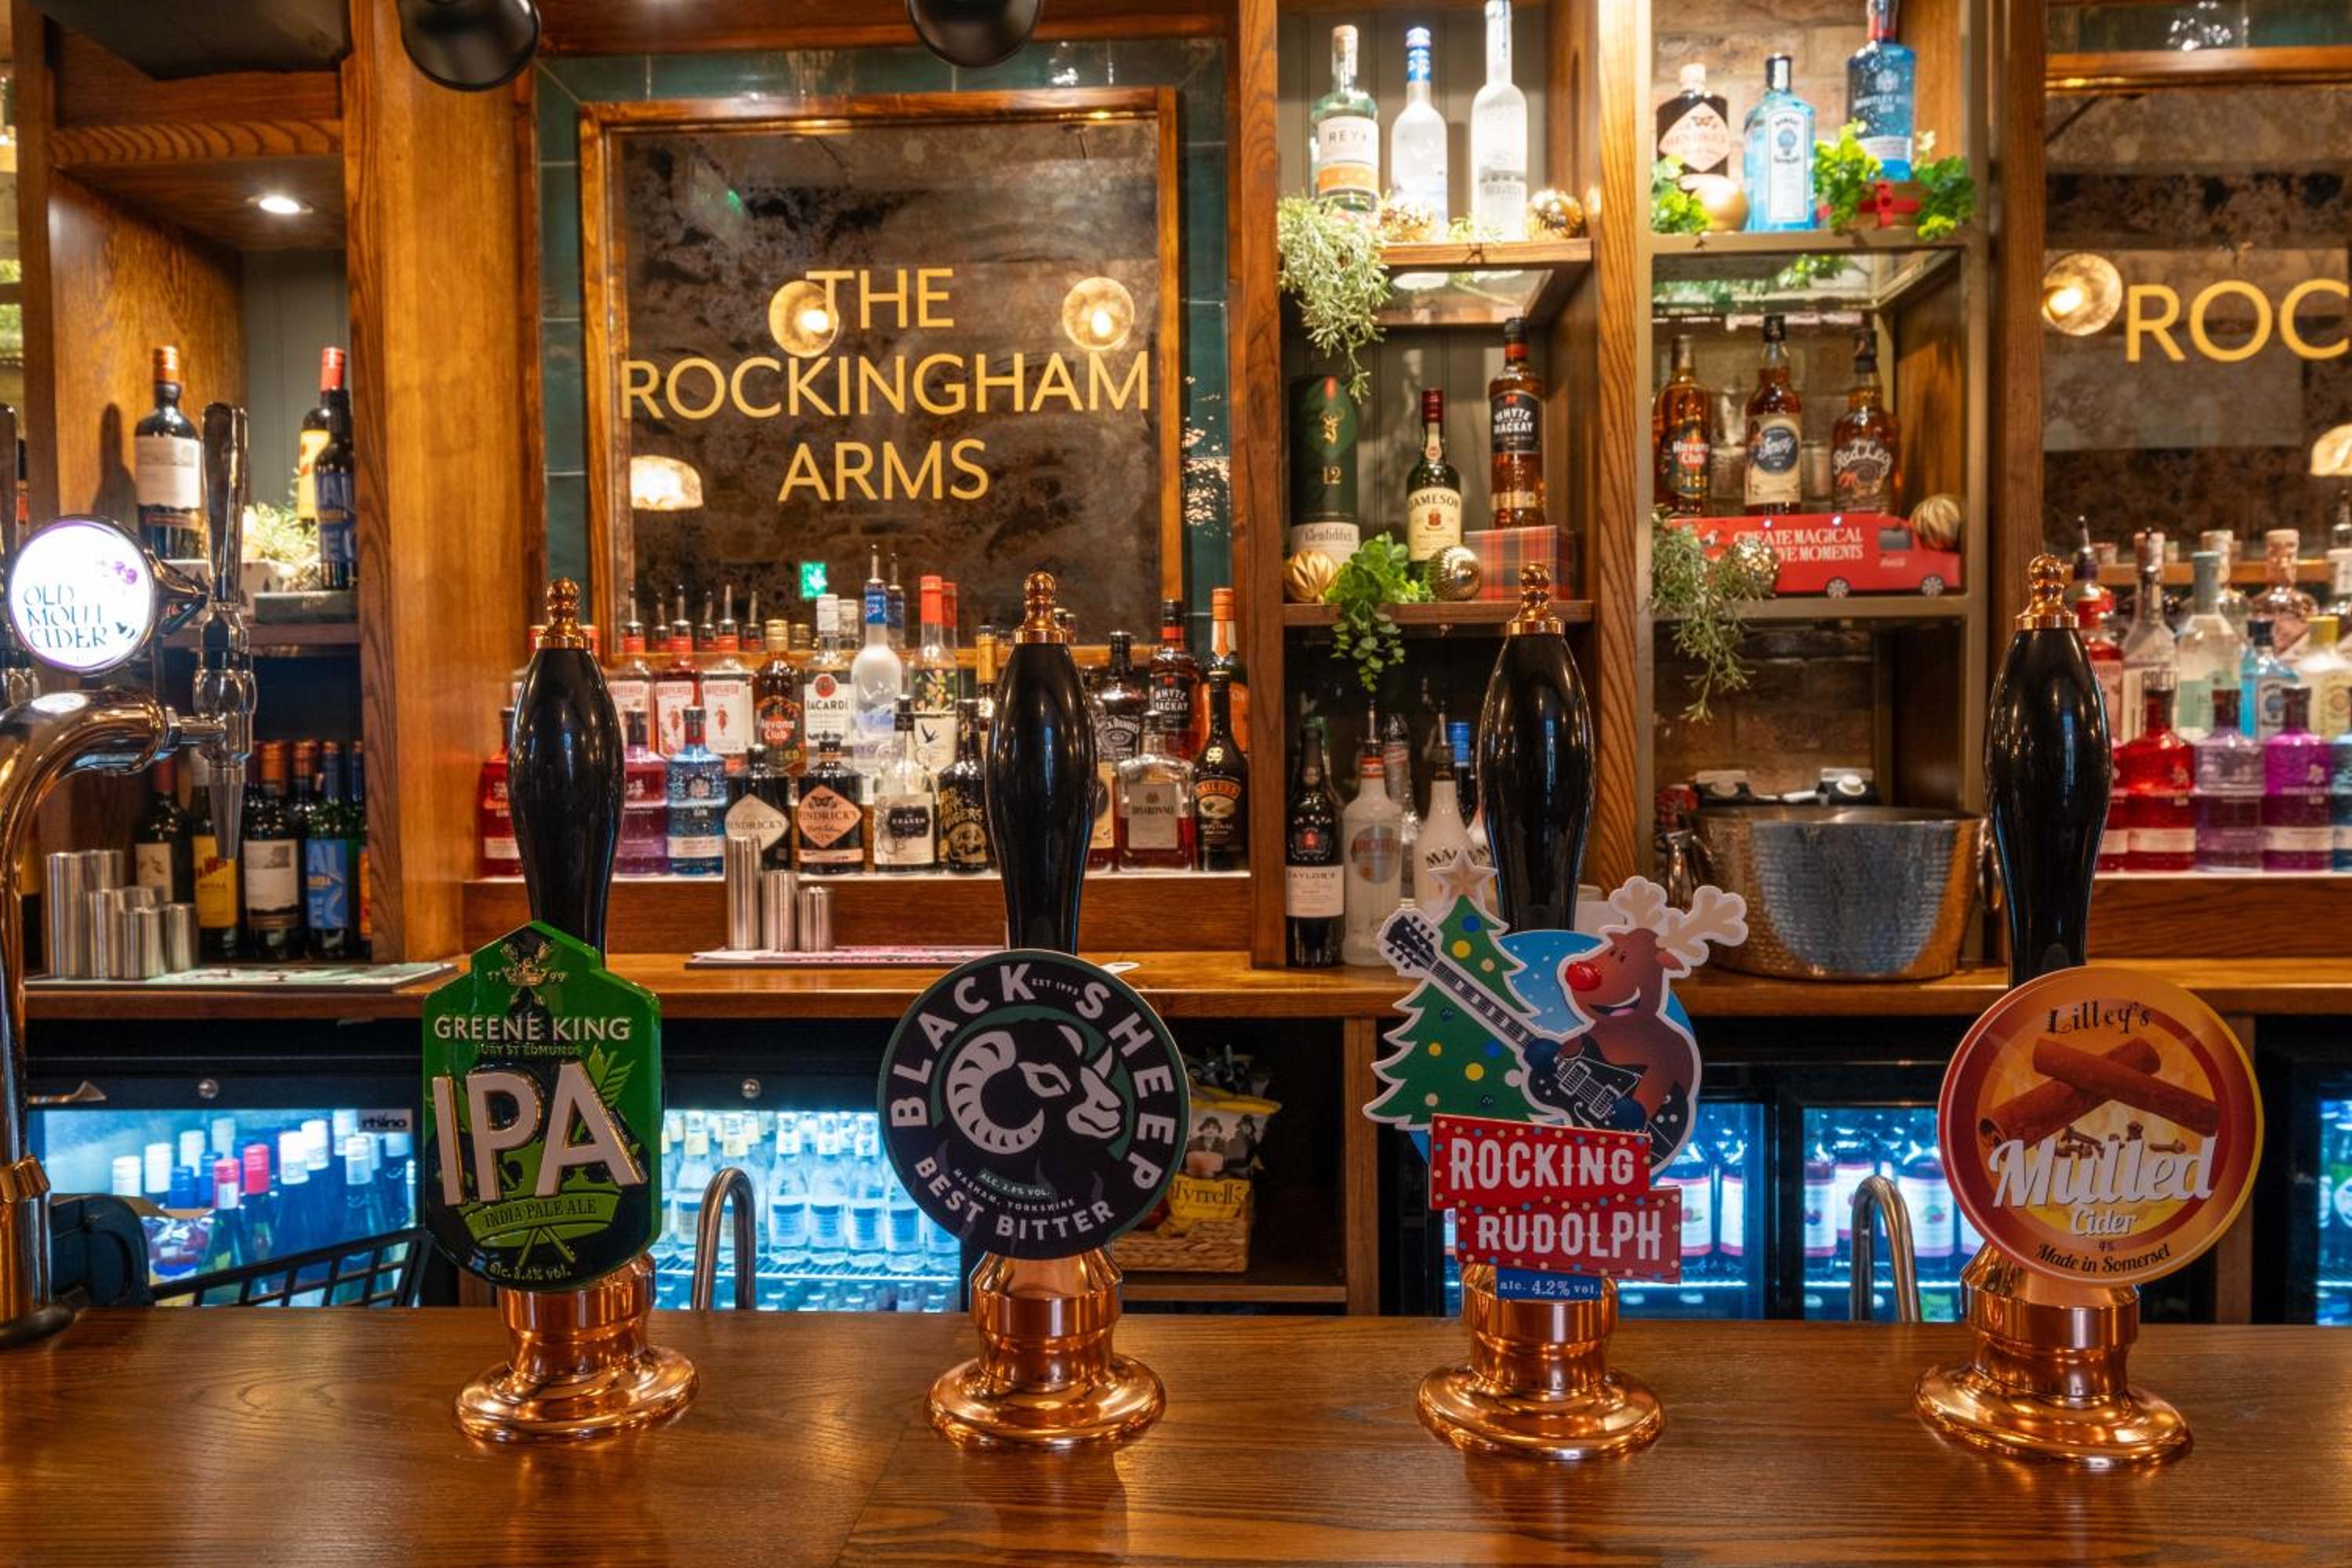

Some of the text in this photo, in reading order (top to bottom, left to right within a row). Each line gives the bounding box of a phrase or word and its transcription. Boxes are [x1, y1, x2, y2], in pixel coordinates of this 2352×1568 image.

[805, 267, 954, 329] THE
[2125, 278, 2350, 363] ROC
[622, 350, 1150, 420] ROCKINGHAM
[1494, 407, 1531, 423] WHYTE
[1494, 422, 1534, 434] MACKAY
[776, 438, 990, 503] ARMS
[1321, 466, 1342, 485] 12
[1409, 495, 1459, 511] JAMESON
[1793, 527, 1864, 545] MAGICAL
[1798, 543, 1864, 562] MOMENTS
[24, 585, 74, 606] OLD
[28, 626, 108, 649] CIDER
[1155, 688, 1187, 701] WHYTE
[764, 727, 789, 740] Club
[434, 1013, 632, 1041] GREENE KING
[2045, 1000, 2154, 1035] Lilley's
[889, 963, 1177, 1190] BLACK SHEEP
[432, 1059, 648, 1206] IPA
[1449, 1137, 1635, 1191] ROCKING
[1989, 1134, 2219, 1208] Mulled
[483, 1197, 597, 1229] INDIA PALE ALE
[914, 1156, 1116, 1241] BEST BITTER
[1007, 1198, 1076, 1212] YORKSHIRE
[1475, 1210, 1662, 1260] RUDOLPH
[2070, 1207, 2141, 1236] Cider
[2036, 1242, 2171, 1273] Made in Somerset
[1499, 1279, 1600, 1297] alc. 4.2% vol.
